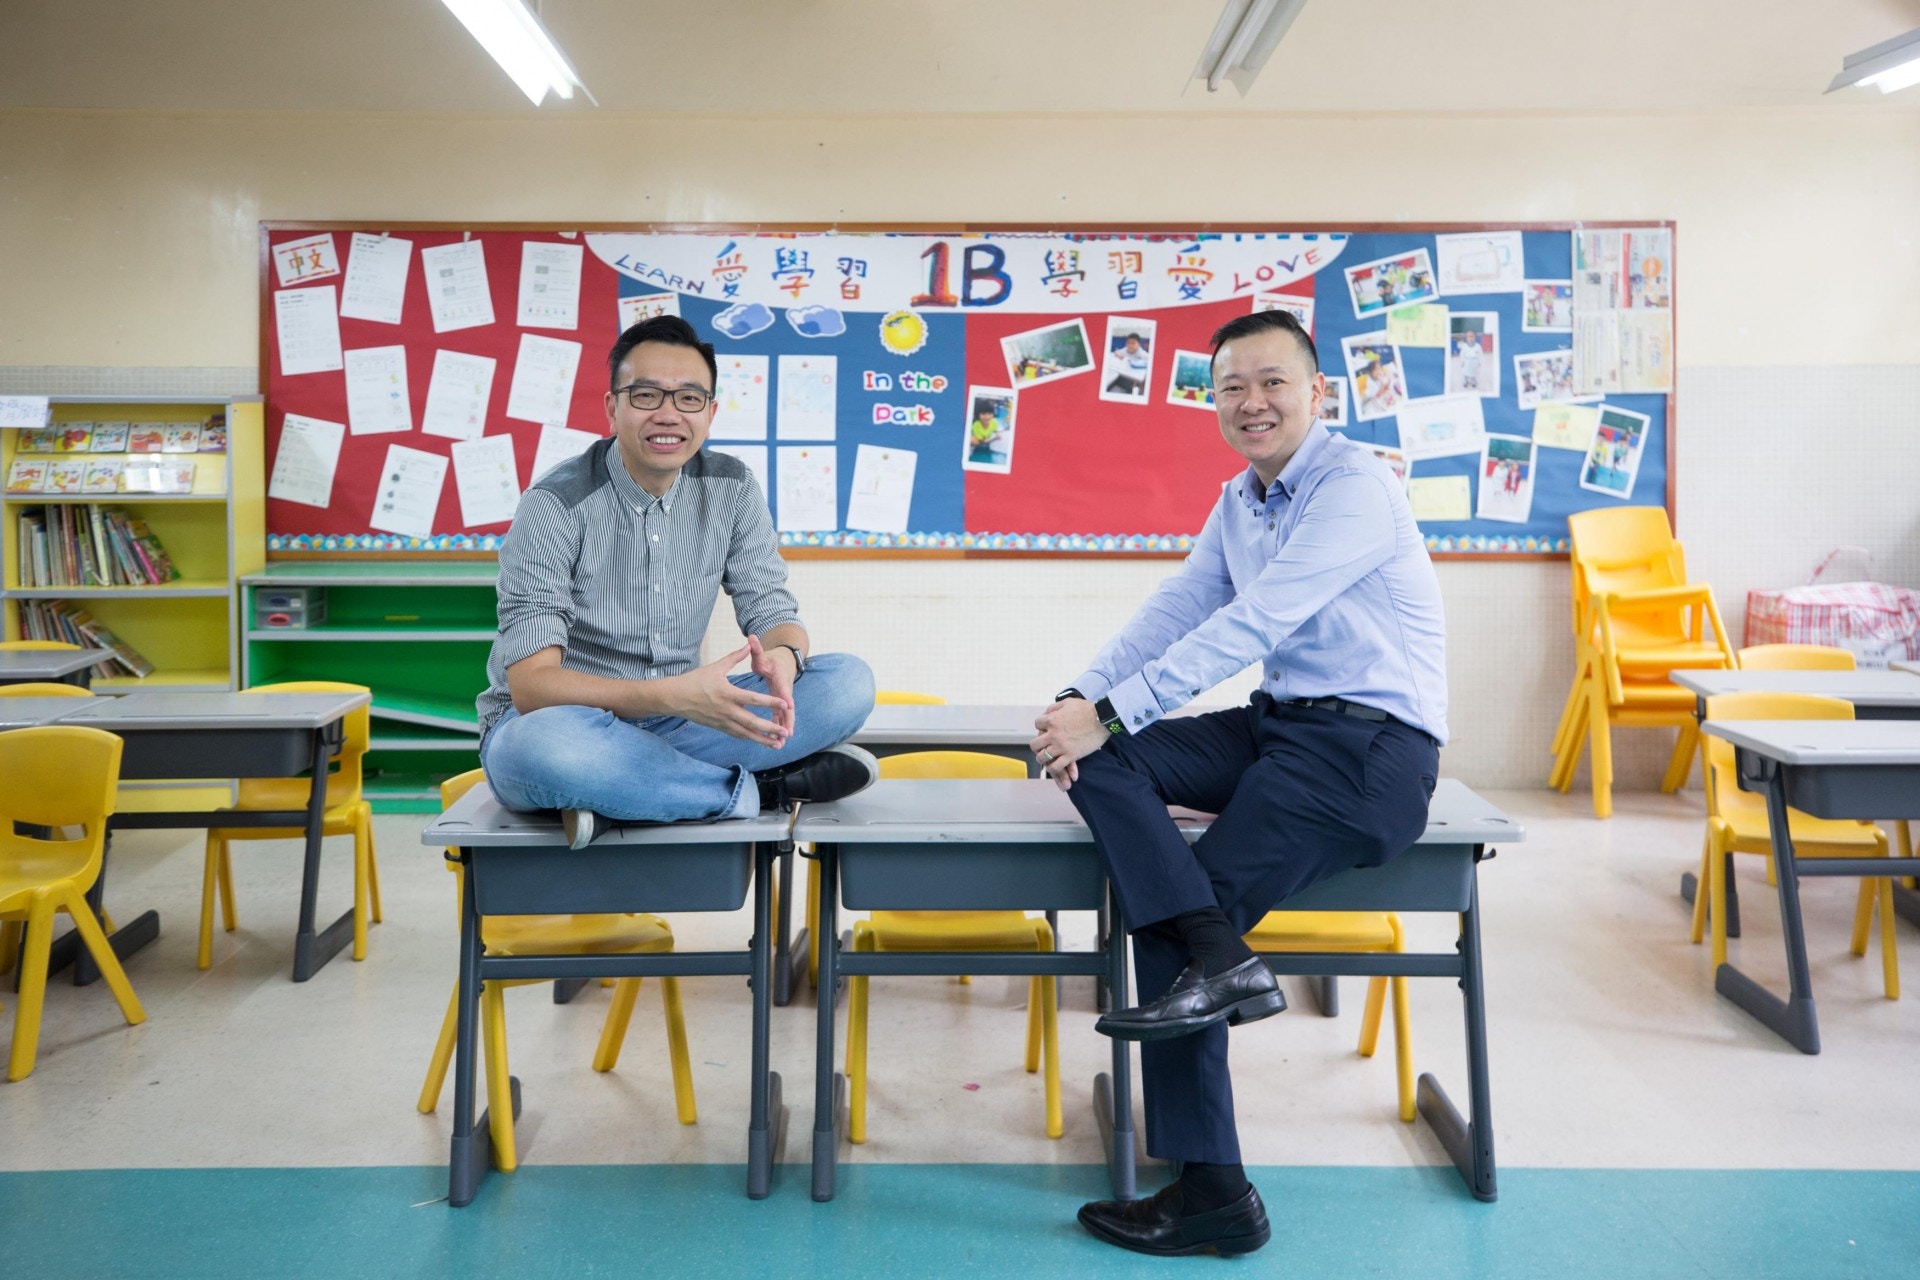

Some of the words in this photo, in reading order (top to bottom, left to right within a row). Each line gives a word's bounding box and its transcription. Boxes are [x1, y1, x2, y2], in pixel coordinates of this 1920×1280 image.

[289, 248, 325, 275] 中文
[614, 254, 705, 294] LEARN
[910, 241, 1012, 307] 1B
[1233, 247, 1322, 293] LOVE
[864, 371, 891, 390] In
[900, 372, 946, 391] the
[874, 404, 933, 424] Park
